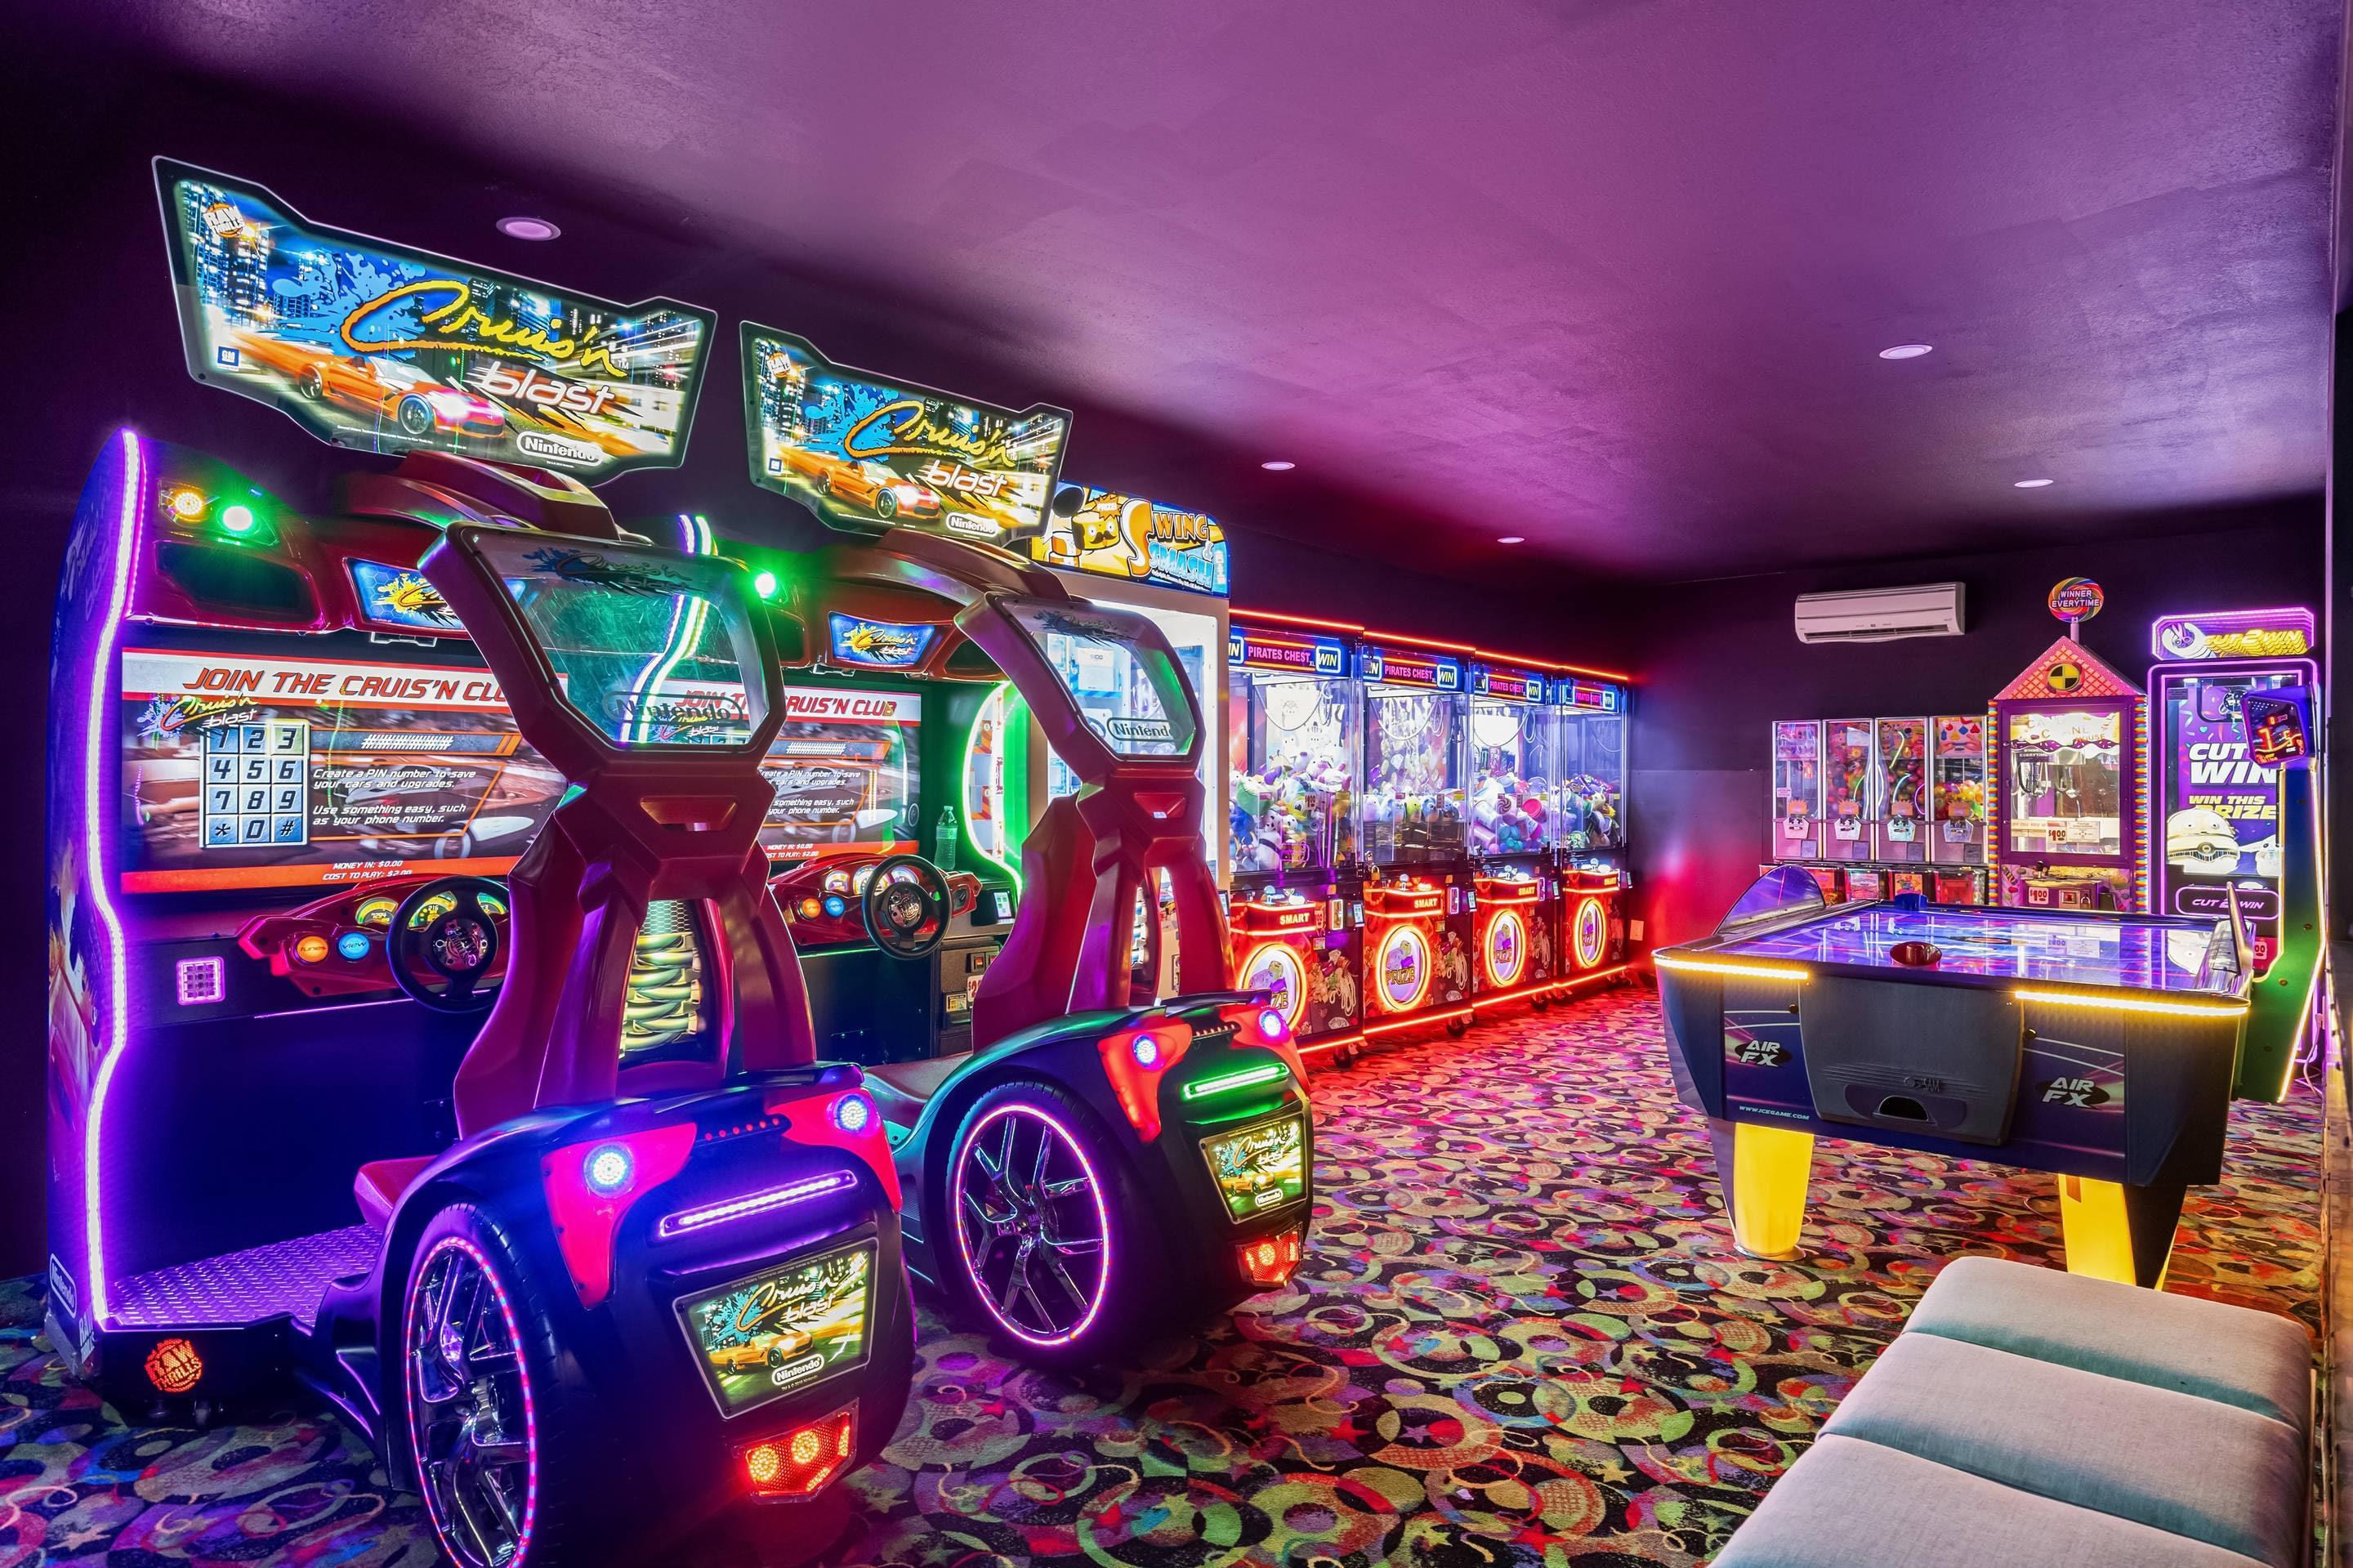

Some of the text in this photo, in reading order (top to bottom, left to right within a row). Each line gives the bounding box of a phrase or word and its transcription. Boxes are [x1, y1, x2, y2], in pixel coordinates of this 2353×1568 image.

[203, 205, 243, 230] RAW
[340, 279, 627, 377] Cruis'n
[480, 360, 615, 414] blast
[843, 400, 1016, 468] Cruis'n
[525, 433, 599, 461] Nintendo
[925, 459, 1008, 497] blast
[950, 516, 996, 534] Nintendo
[1148, 541, 1215, 589] SMASH
[2060, 590, 2092, 598] WINNER
[2052, 599, 2101, 608] EVERYTIME
[1228, 642, 1240, 657] IN
[1248, 646, 1283, 659] PIRATES
[1284, 649, 1311, 663] CHEST
[1318, 652, 1337, 668] WIN
[1384, 665, 1412, 677] PIRATES
[1412, 667, 1433, 680] CHEST
[1439, 668, 1454, 683] WIN
[183, 667, 507, 703] JOIN THE CRUIS'N CLU
[1489, 681, 1509, 691] PIRATES
[1509, 682, 1525, 694] CHEST
[1529, 684, 1539, 696] WIN
[615, 699, 731, 720] Nntendo
[785, 695, 897, 717] RUIS'N CLUB
[203, 708, 258, 728] blast
[218, 727, 297, 749] 1 2 3
[2189, 742, 2248, 761] CUT
[213, 759, 297, 780] 4 5 6
[313, 768, 353, 778] Create
[366, 769, 388, 778] PIN
[389, 770, 431, 778] number
[435, 770, 445, 778] to
[788, 770, 803, 778] PIN
[313, 780, 340, 789] your
[376, 779, 398, 788] and
[400, 779, 455, 789] upgrades.
[795, 778, 810, 786] and
[810, 779, 847, 787] upgrades.
[215, 790, 297, 810] 7 8 9
[773, 799, 812, 807] something
[813, 799, 834, 807] easy,
[2189, 795, 2266, 805] WIN THIS
[312, 803, 467, 815] Use something easy, such
[768, 807, 785, 815] your
[788, 806, 811, 815] phone
[333, 817, 360, 826] your
[364, 815, 400, 825] phone
[402, 815, 444, 824] number.
[245, 820, 294, 839] 0 #
[333, 862, 363, 870] MONEY
[322, 873, 347, 881] COST
[1518, 886, 1536, 896] SMART
[1413, 898, 1438, 909] SMART
[2191, 898, 2219, 906] CUT
[2239, 900, 2265, 909] WIN
[1279, 913, 1310, 926] SMART
[1745, 1039, 1781, 1054] AIR
[1739, 1051, 1779, 1068] FX
[2049, 1076, 2095, 1092] AIR
[2042, 1089, 2092, 1108] FX
[1738, 1104, 1811, 1121] WWW.ICEGAME.COM
[784, 1292, 837, 1322] blast
[144, 1340, 196, 1381] RAW
[776, 1359, 820, 1382] Nintendo
